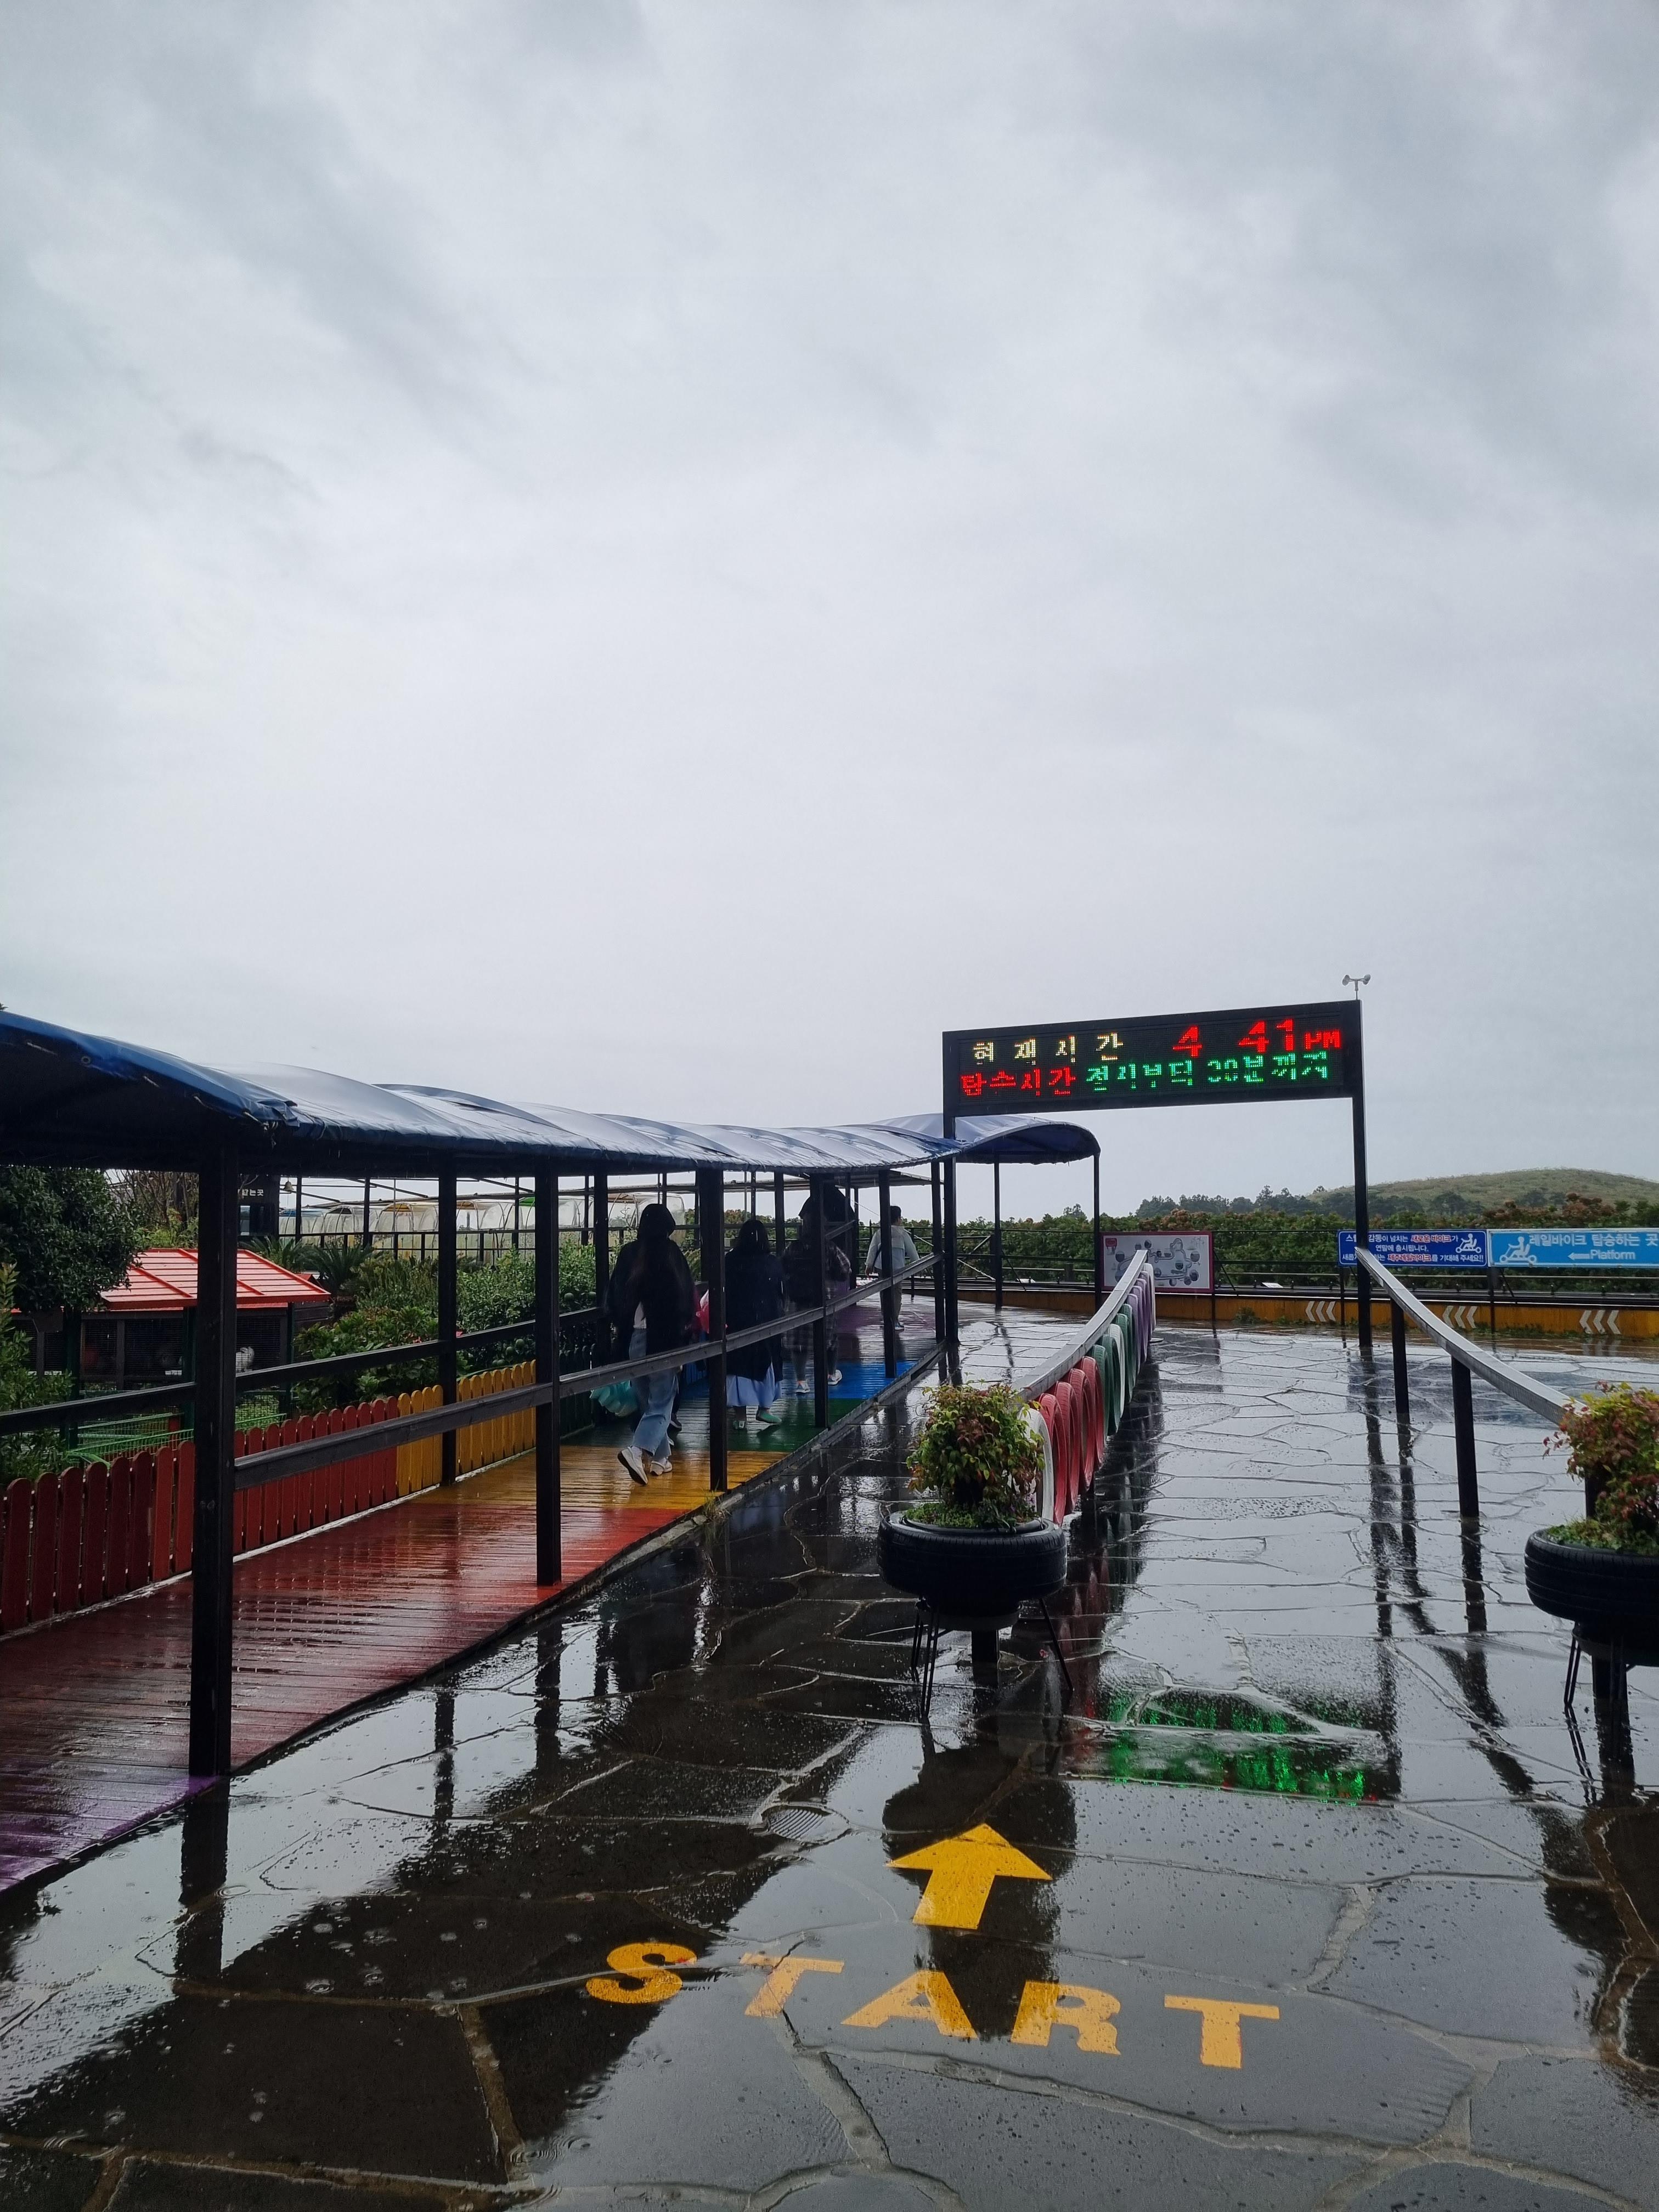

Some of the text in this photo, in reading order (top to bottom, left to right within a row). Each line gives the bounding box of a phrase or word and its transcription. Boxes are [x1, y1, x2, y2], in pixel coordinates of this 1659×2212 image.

[1237, 1019, 1294, 1053] 41
[1529, 1233, 1659, 1247] 레일바이크 탑승하는 곳
[1590, 1249, 1635, 1260] Platform
[584, 1942, 1280, 2070] START
